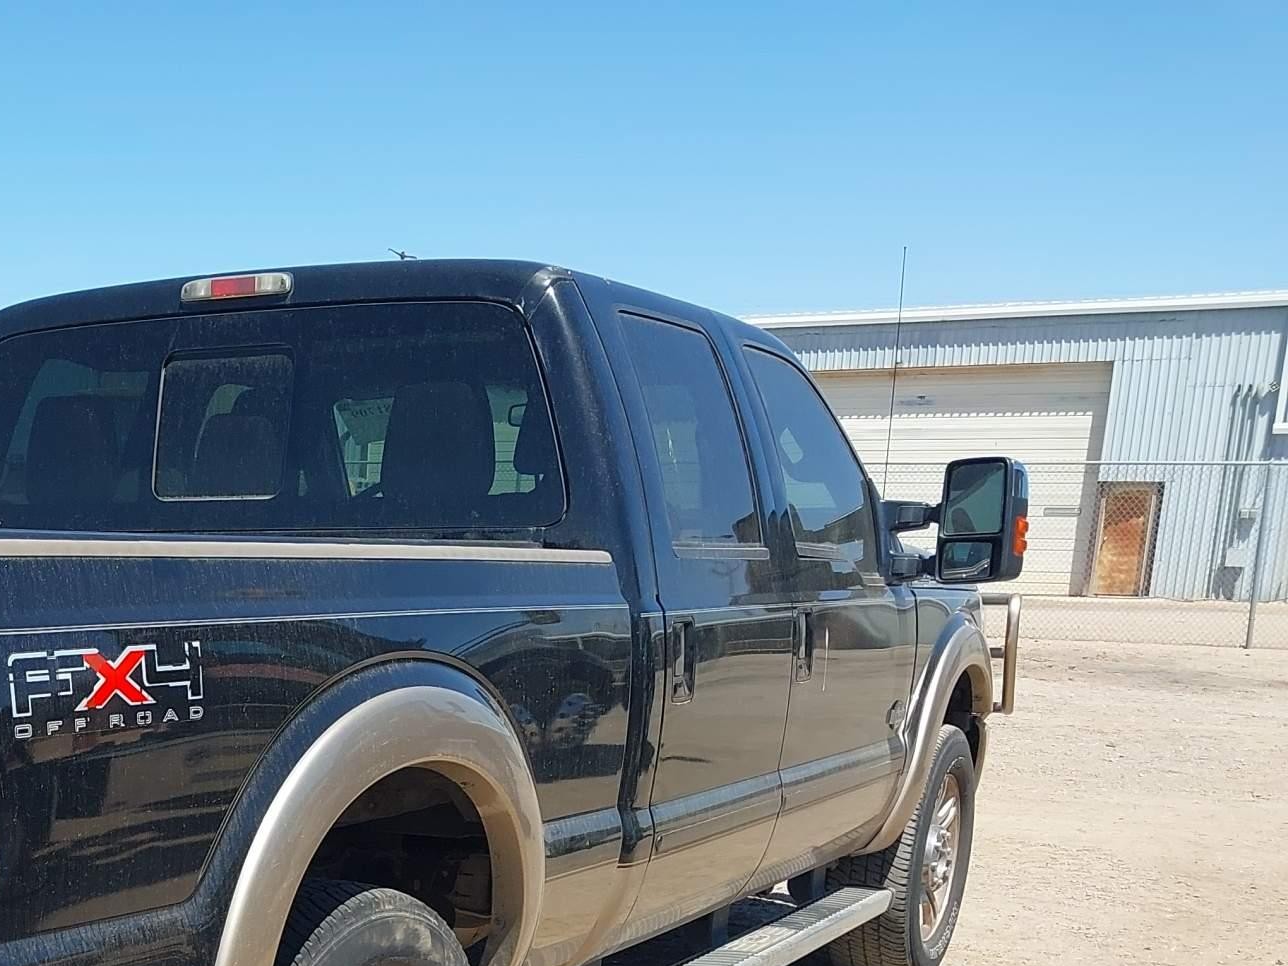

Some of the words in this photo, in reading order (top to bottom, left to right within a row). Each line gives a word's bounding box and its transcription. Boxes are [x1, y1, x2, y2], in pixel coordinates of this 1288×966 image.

[8, 641, 204, 718] FX4
[14, 716, 91, 739] OFF
[109, 705, 204, 729] ROAD
